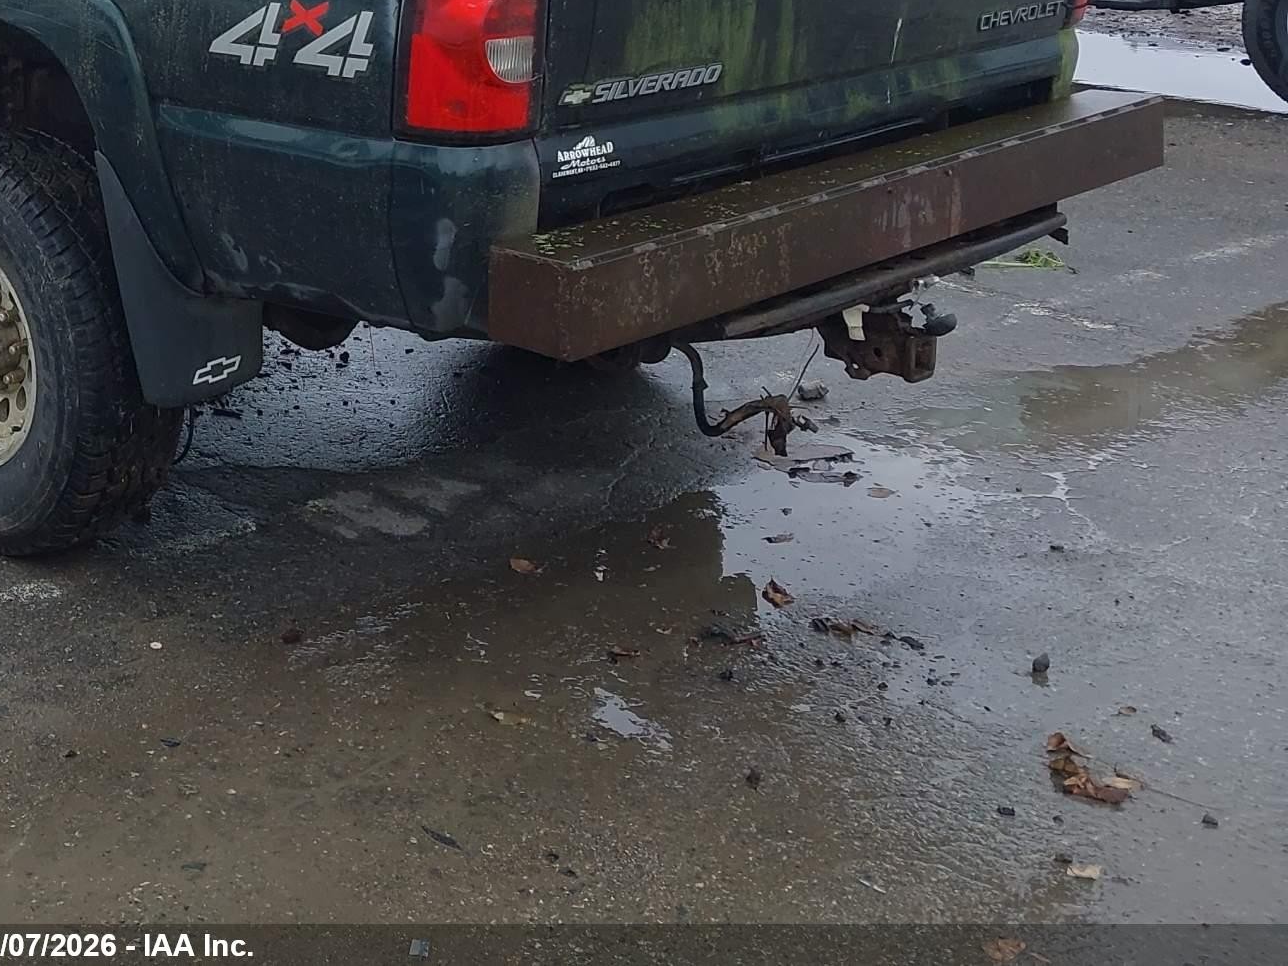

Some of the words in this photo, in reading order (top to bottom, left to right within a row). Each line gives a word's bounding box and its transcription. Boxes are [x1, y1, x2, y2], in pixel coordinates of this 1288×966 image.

[980, 0, 1064, 31] CHEVROLET
[592, 64, 723, 103] SILVERADO
[557, 141, 613, 162] ARROWHEAD
[560, 156, 606, 170] Motors
